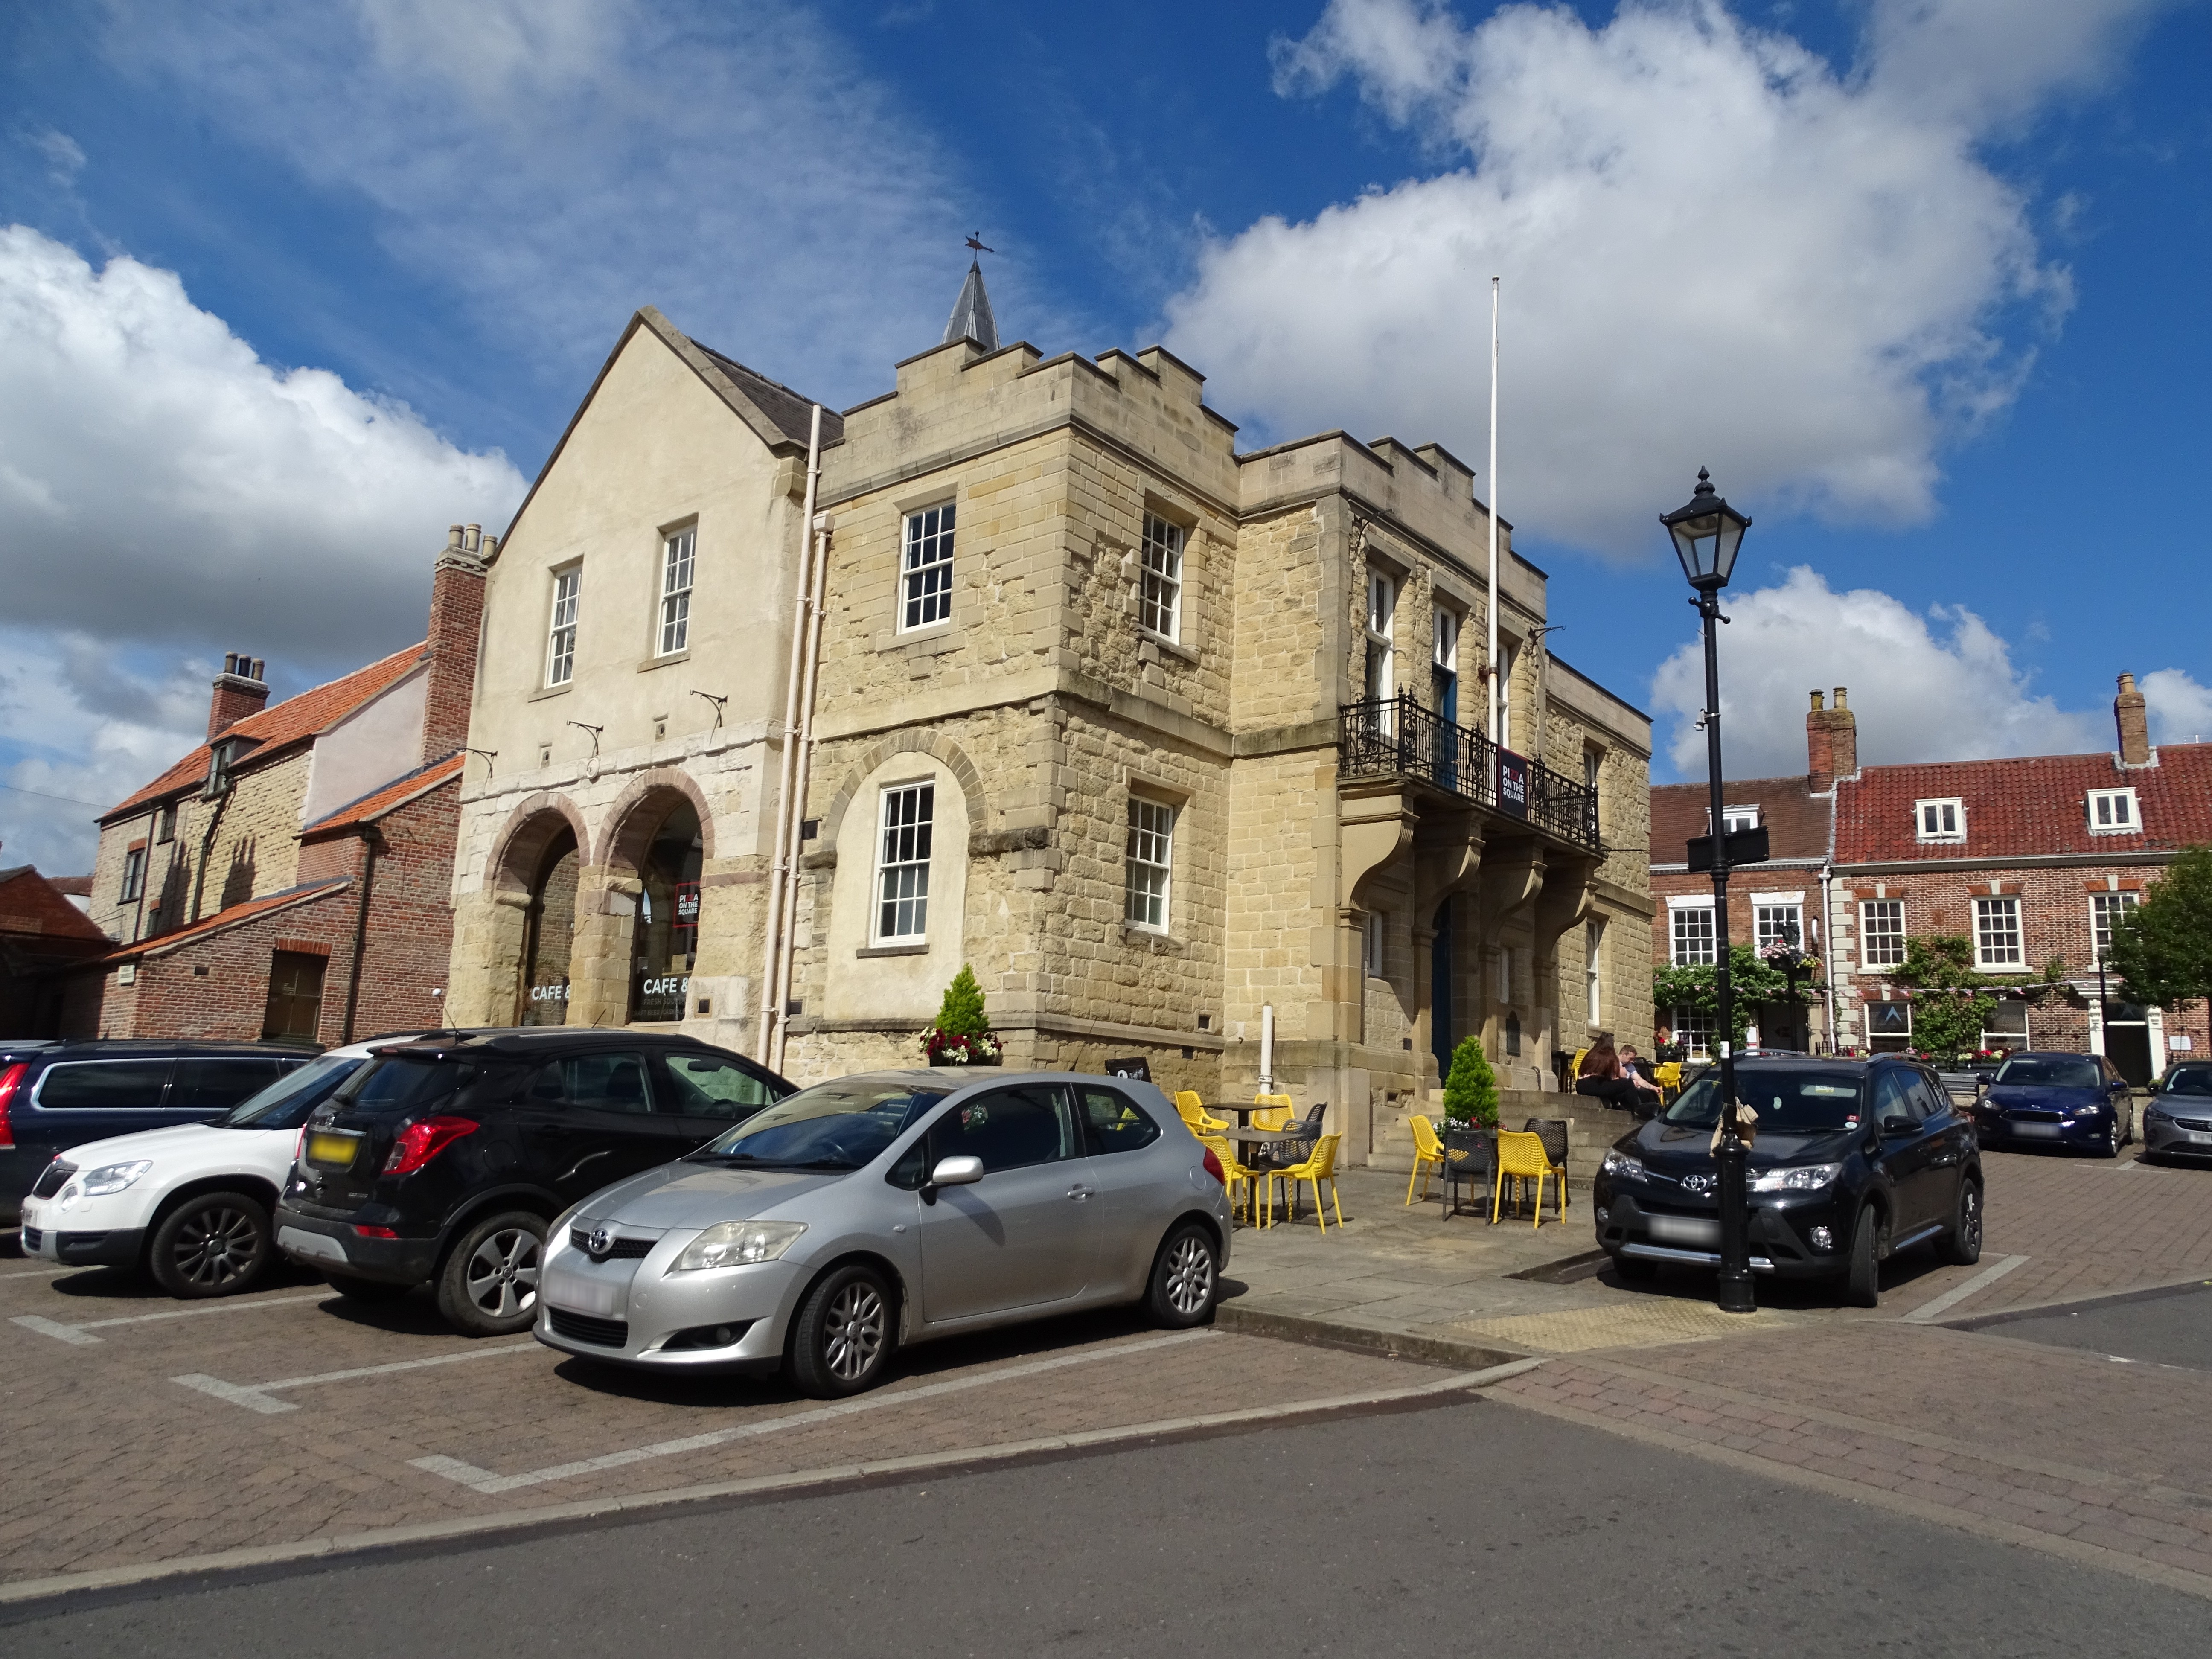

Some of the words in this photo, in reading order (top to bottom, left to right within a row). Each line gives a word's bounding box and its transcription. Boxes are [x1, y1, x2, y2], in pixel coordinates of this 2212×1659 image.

[1503, 765, 1524, 785] PIZZA
[1503, 777, 1512, 789] ON
[1513, 781, 1524, 794] THE
[1503, 787, 1524, 803] SQUARE
[532, 985, 562, 1000] CAFE
[643, 978, 678, 994] CAFE
[681, 977, 689, 992] &
